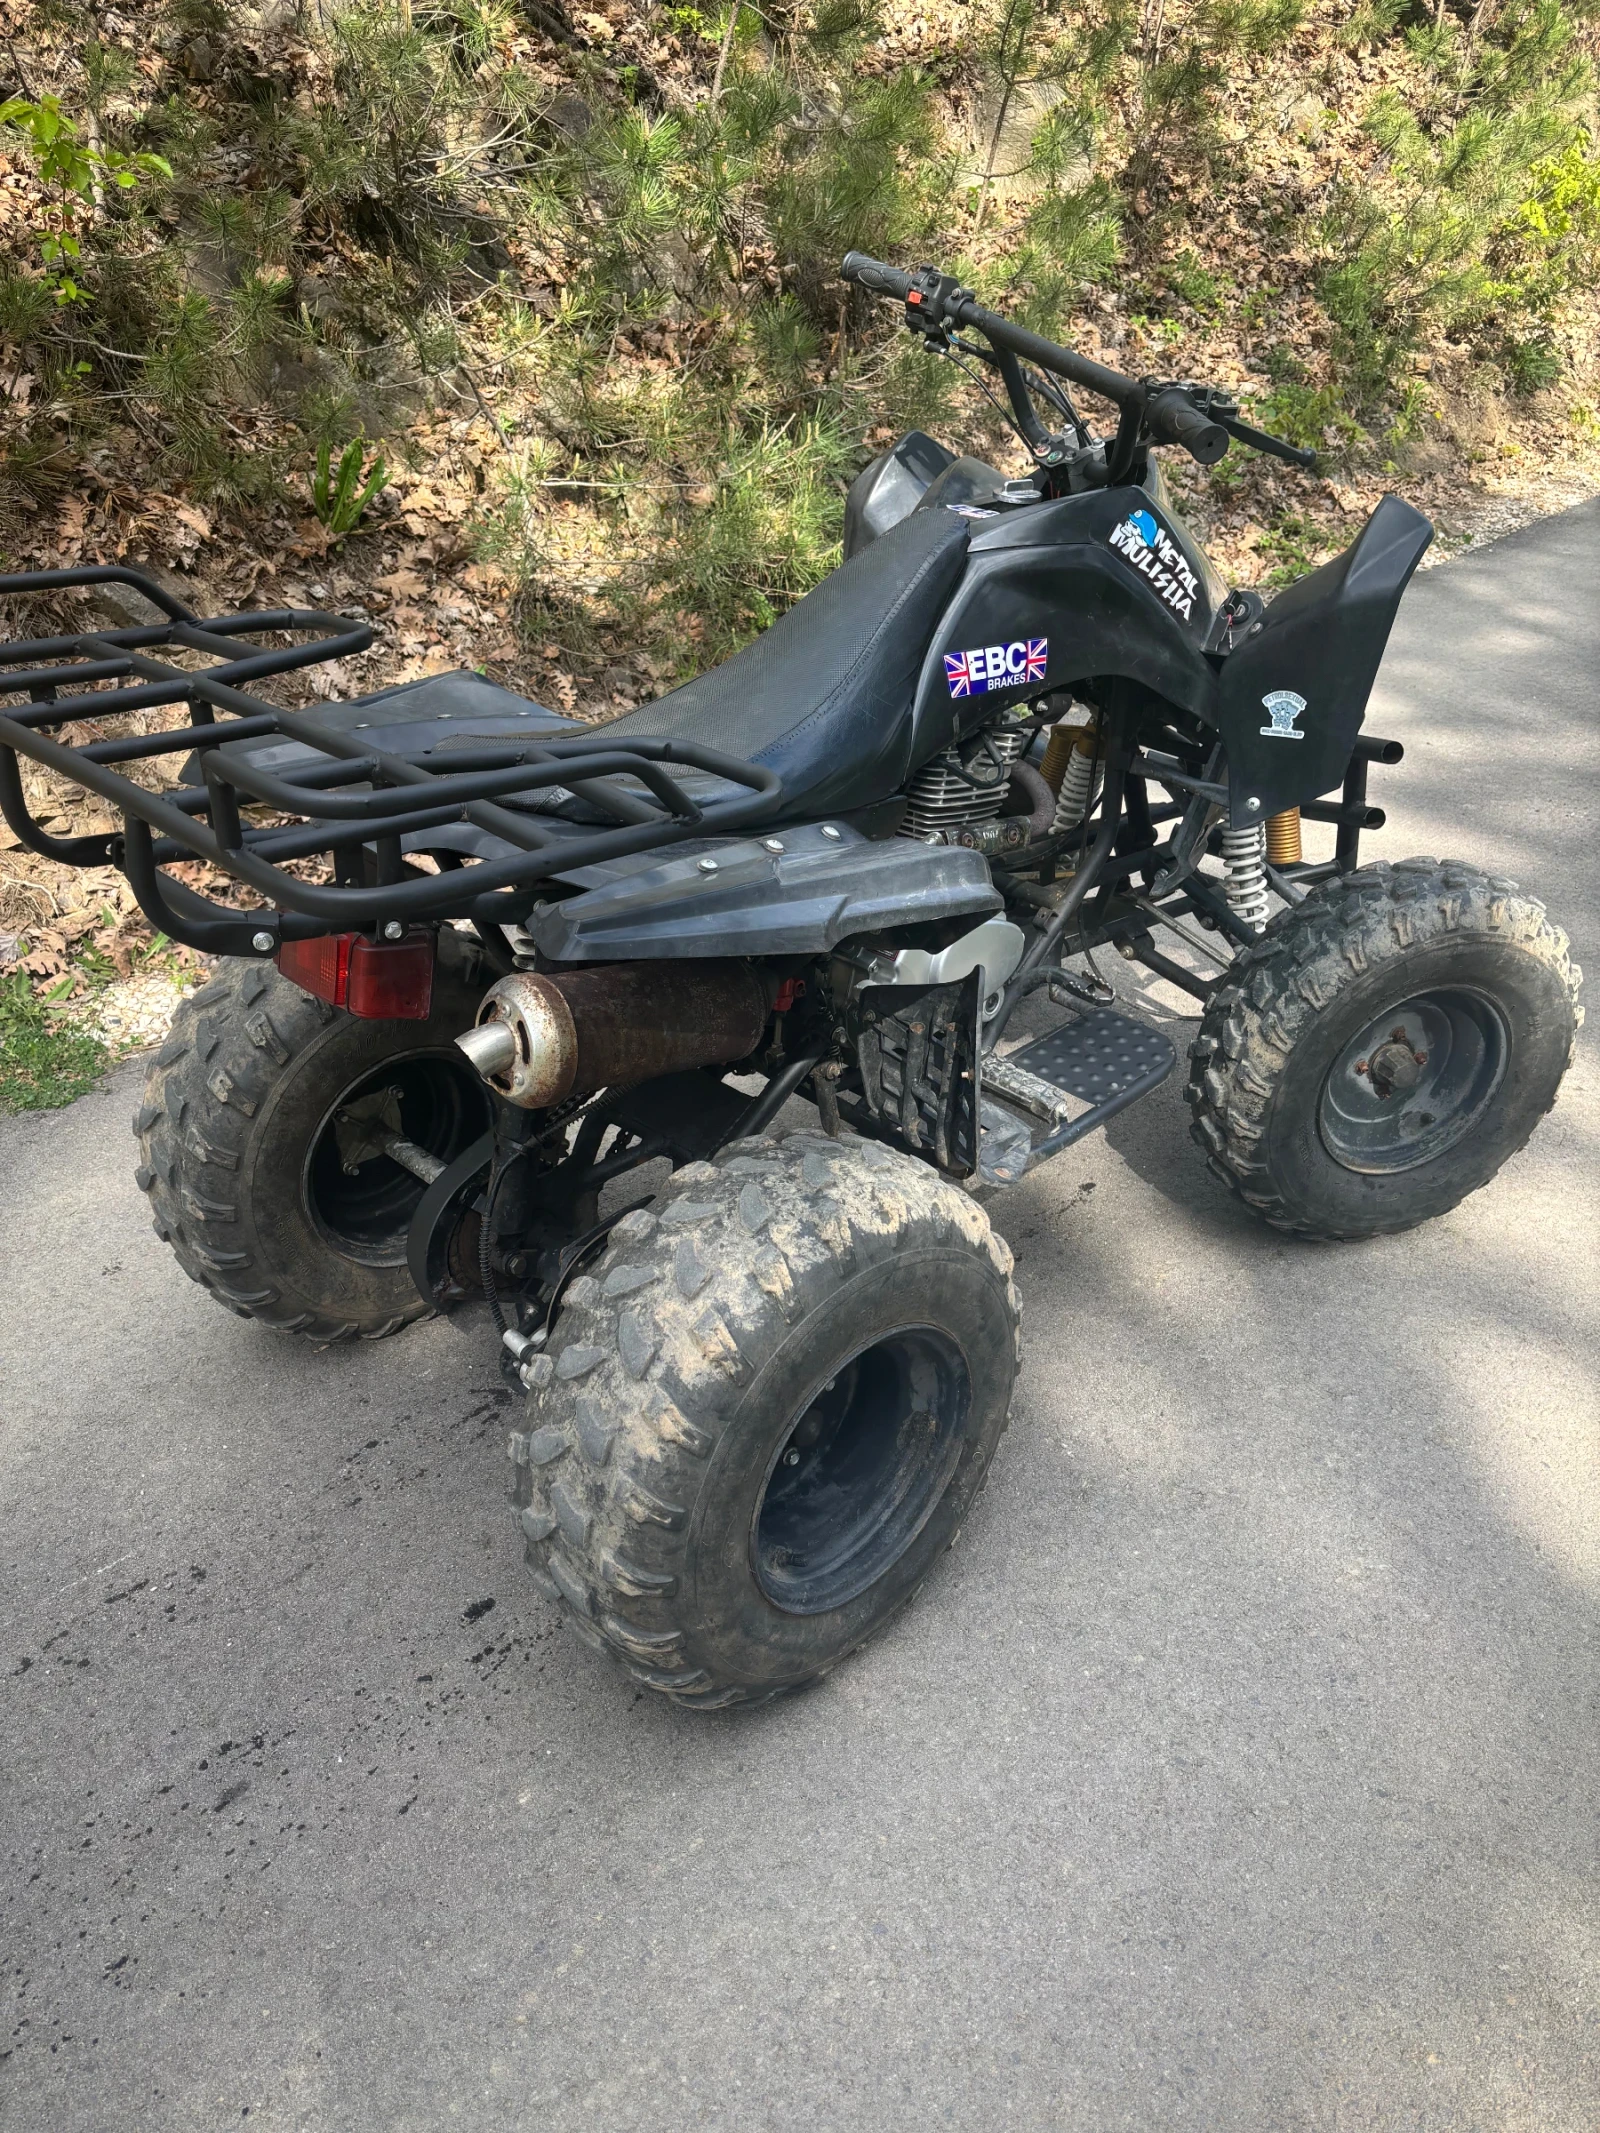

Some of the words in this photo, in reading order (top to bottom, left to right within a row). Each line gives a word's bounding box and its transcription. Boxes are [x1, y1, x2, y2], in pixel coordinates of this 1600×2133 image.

[1109, 522, 1192, 621] MULISHA
[1153, 527, 1198, 601] METAL
[966, 642, 1027, 681] EBC
[987, 673, 1026, 691] BRAKES
